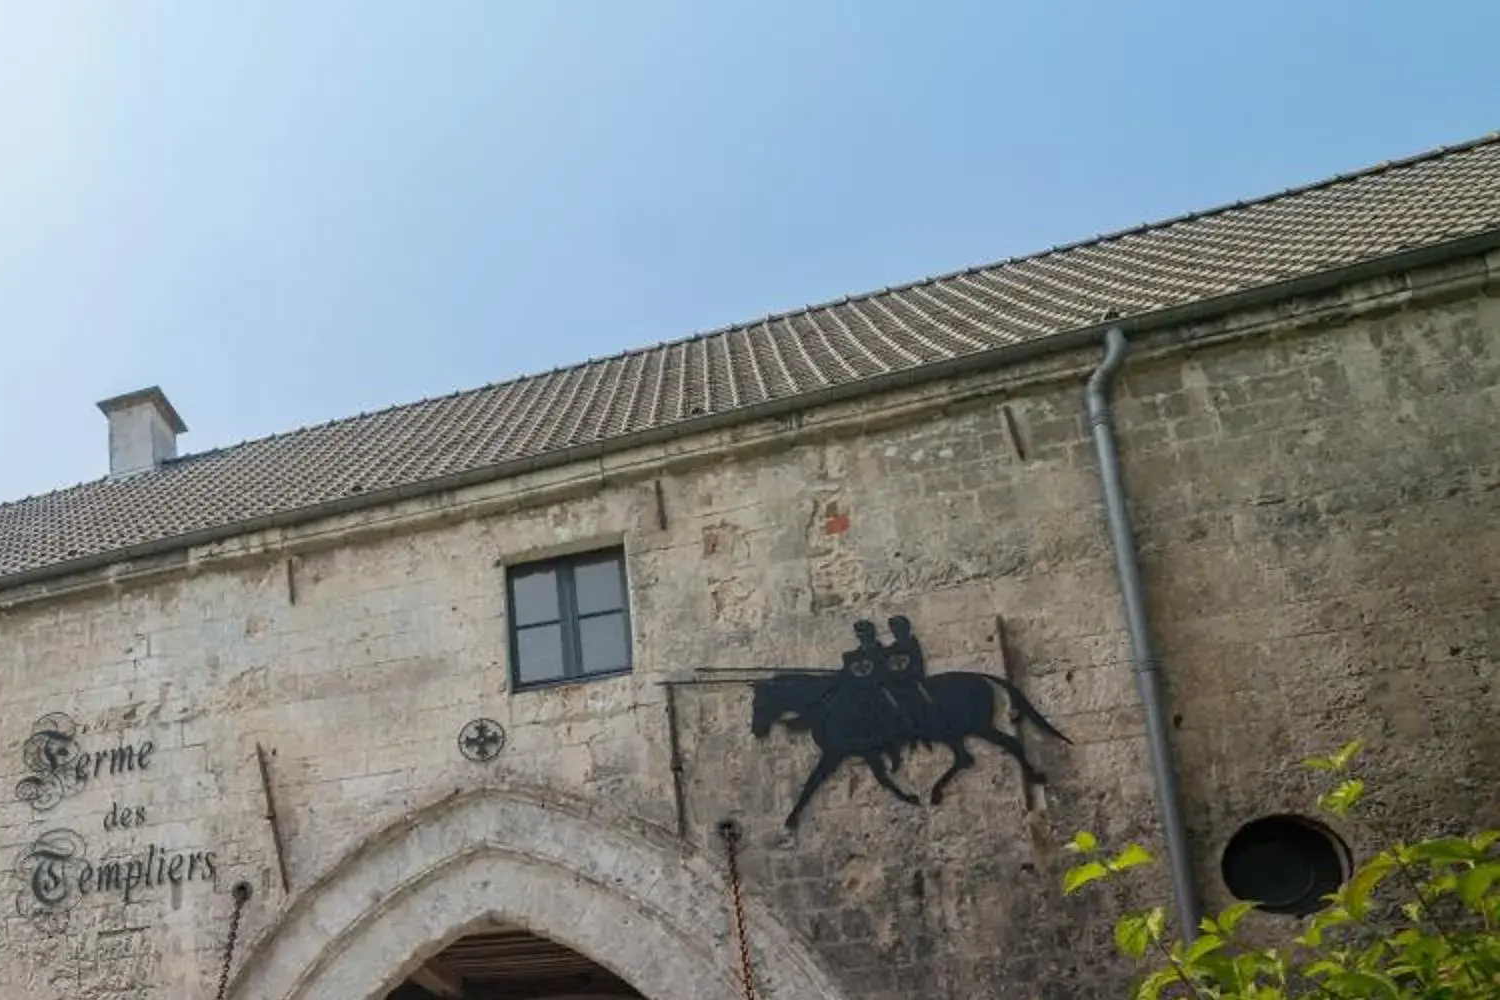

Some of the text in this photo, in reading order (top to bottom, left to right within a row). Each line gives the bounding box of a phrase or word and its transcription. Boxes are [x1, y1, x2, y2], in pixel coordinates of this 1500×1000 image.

[15, 711, 154, 811] Ferme
[103, 801, 146, 831] des
[15, 828, 217, 916] Templiers
